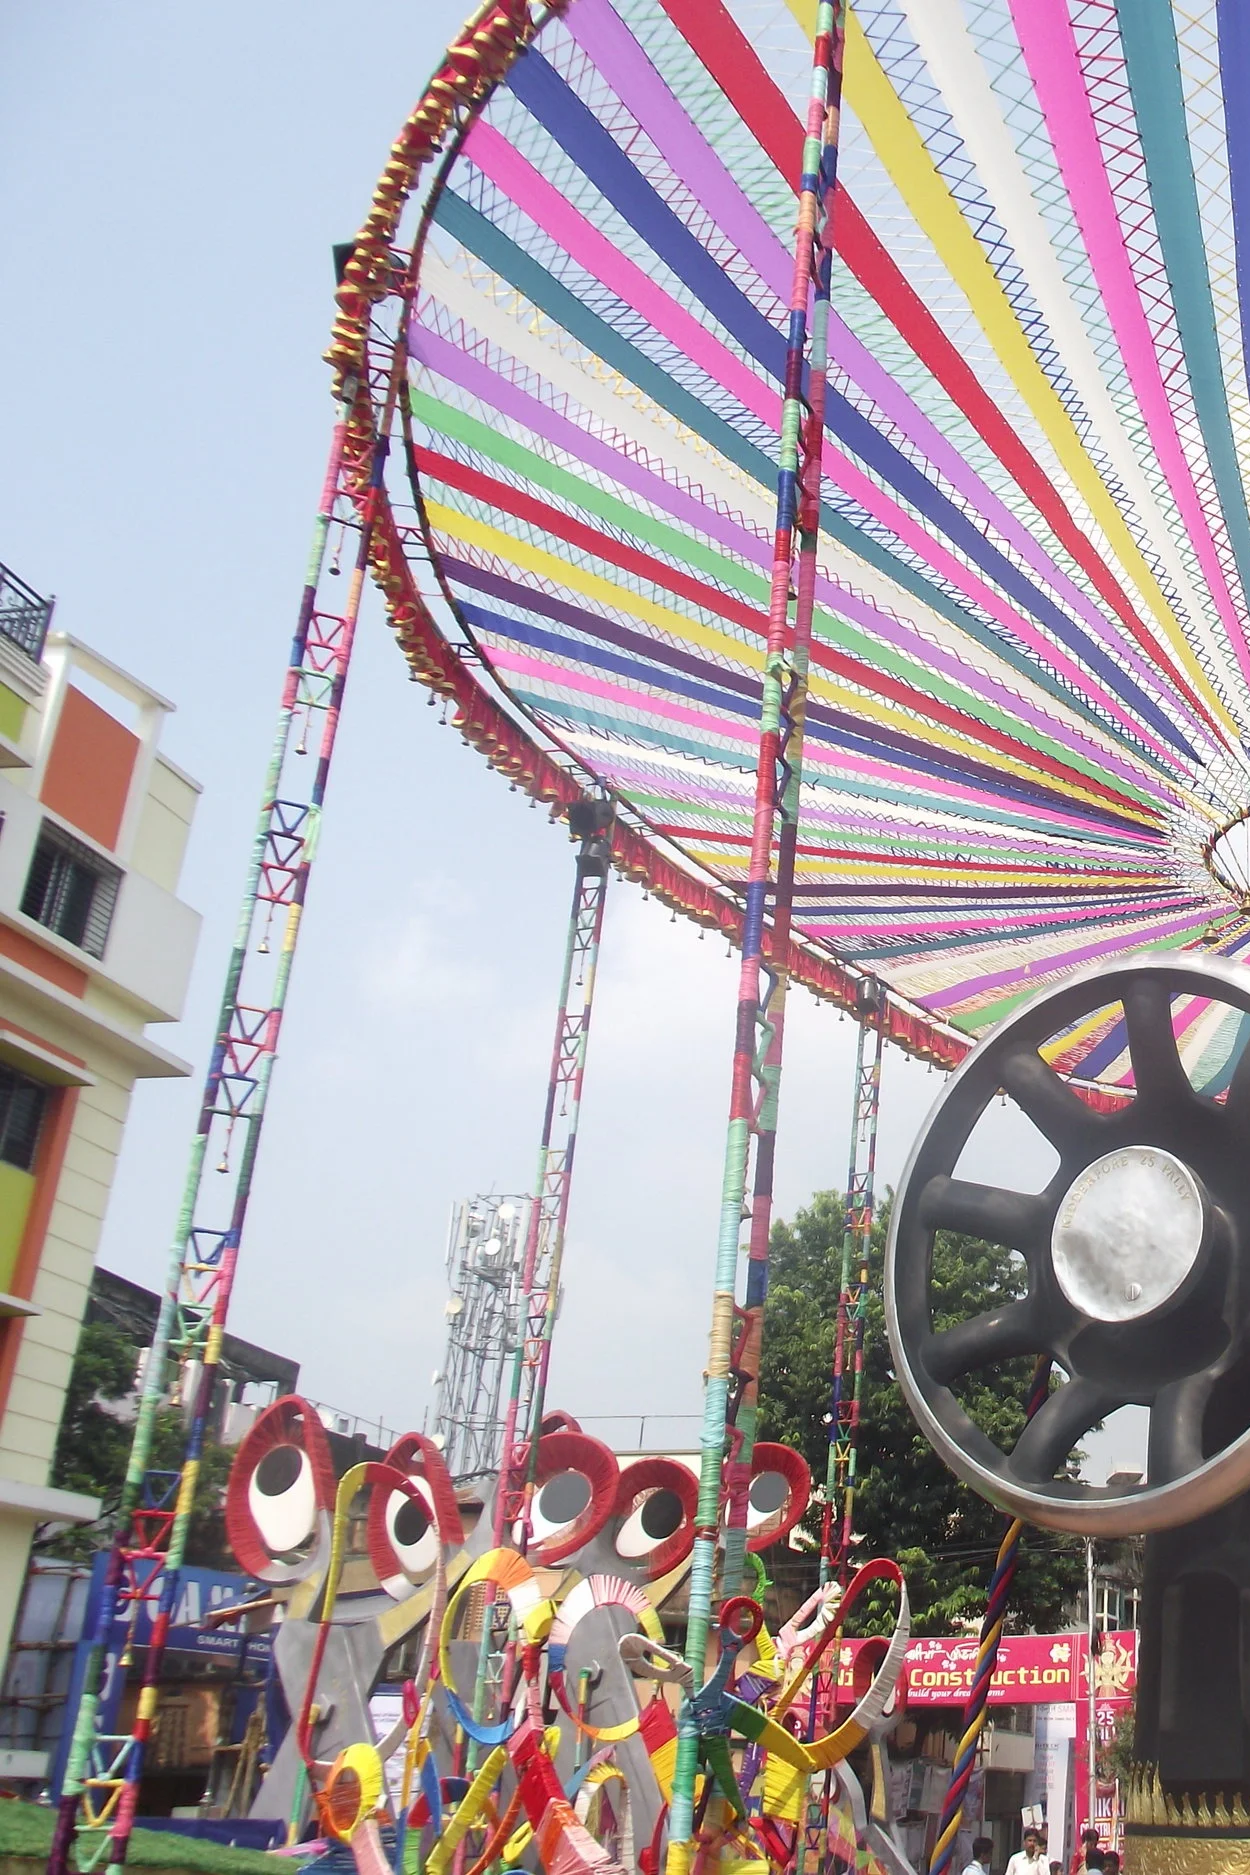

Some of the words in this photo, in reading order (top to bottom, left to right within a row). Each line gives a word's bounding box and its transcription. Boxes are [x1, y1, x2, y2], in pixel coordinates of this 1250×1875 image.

[1139, 1154, 1156, 1168] 25
[1162, 1165, 1192, 1200] PALLY
[196, 1635, 240, 1648] SMART
[910, 1666, 1070, 1687] Constuction
[907, 1688, 929, 1697] build
[931, 1689, 952, 1701] your
[987, 1689, 1006, 1697] ome
[1096, 1711, 1115, 1726] 25
